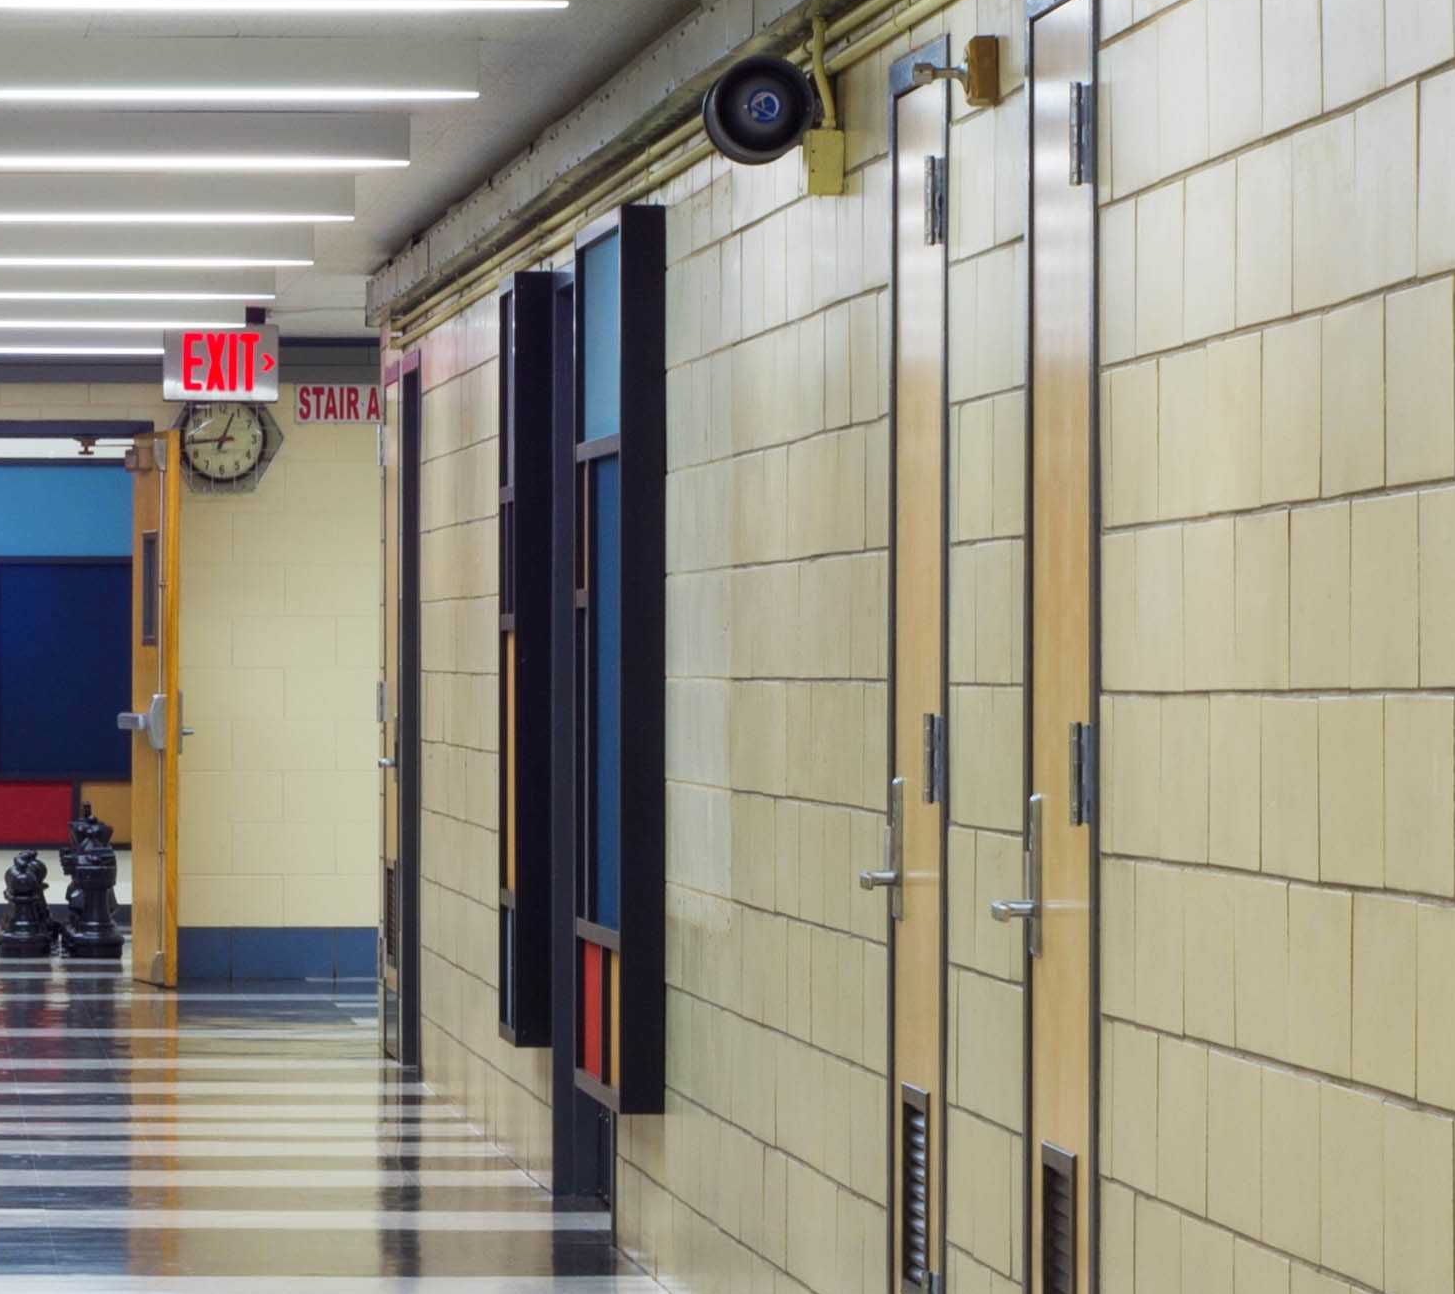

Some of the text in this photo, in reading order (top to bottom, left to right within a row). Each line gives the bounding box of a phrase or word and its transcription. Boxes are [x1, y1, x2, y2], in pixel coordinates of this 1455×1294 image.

[182, 332, 260, 392] EXIT
[298, 386, 381, 420] STAIR A
